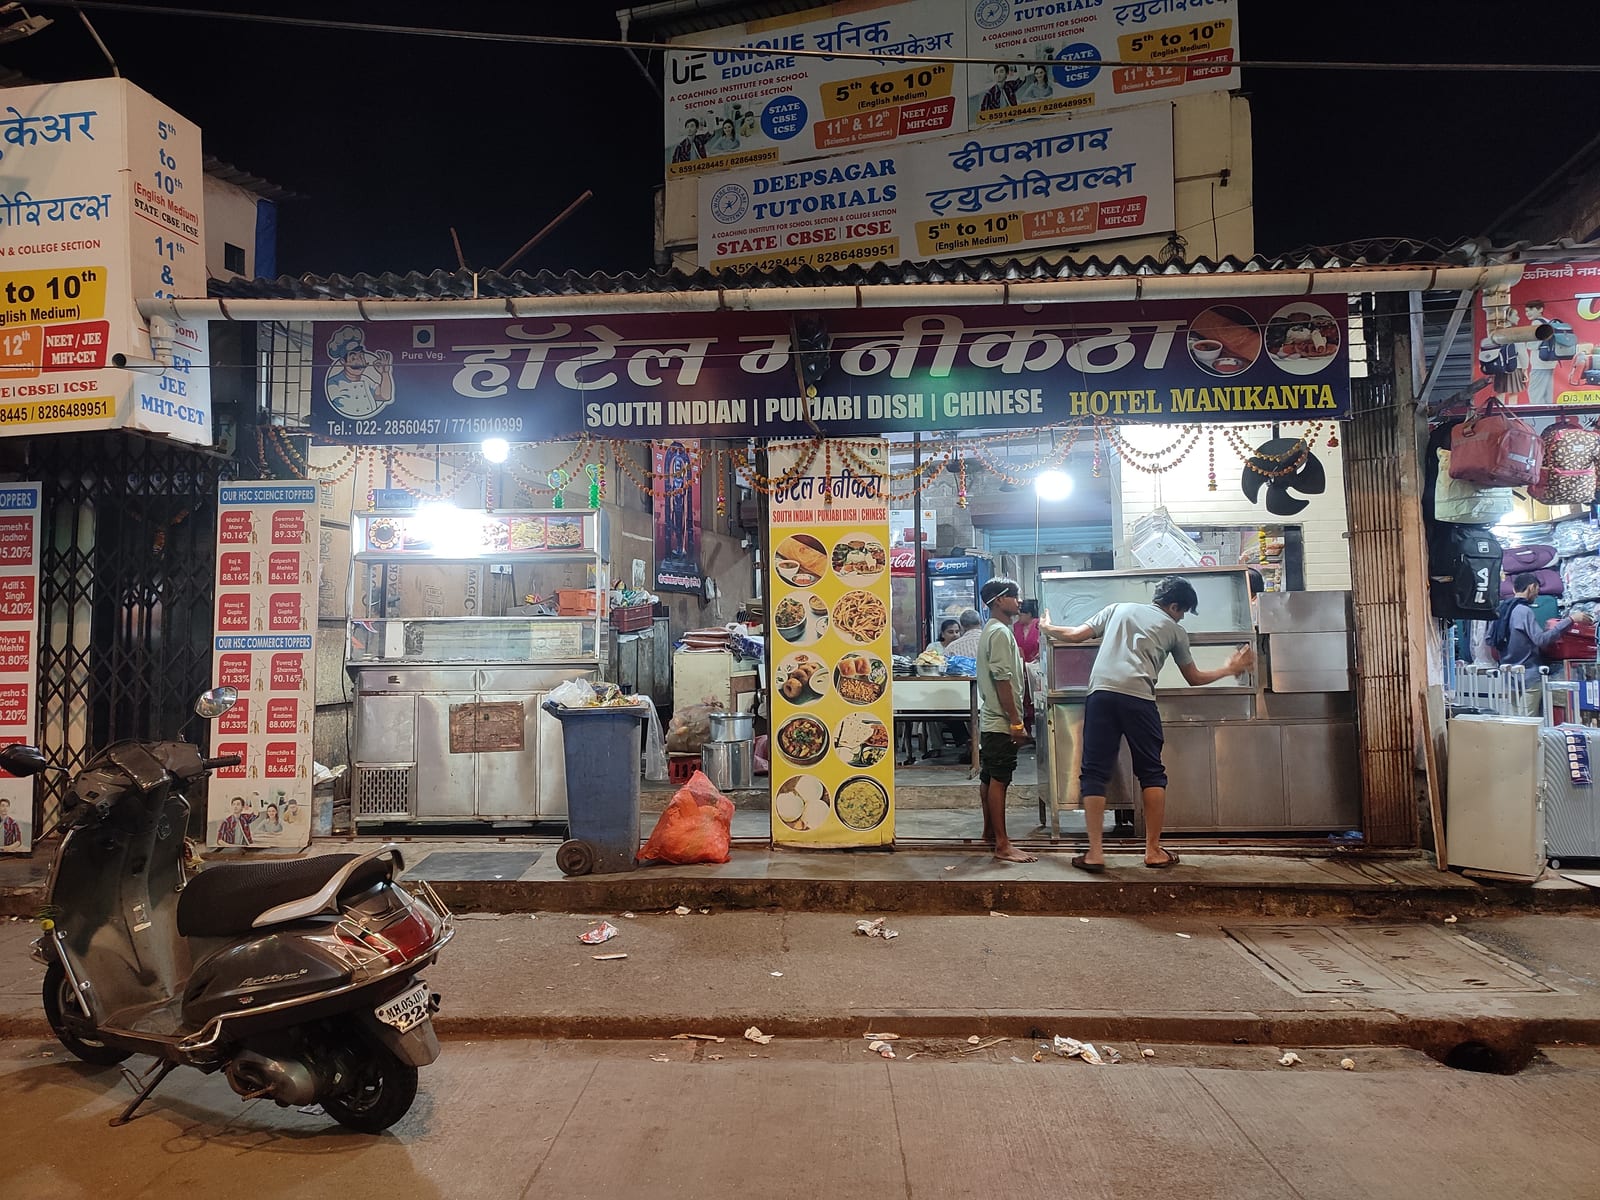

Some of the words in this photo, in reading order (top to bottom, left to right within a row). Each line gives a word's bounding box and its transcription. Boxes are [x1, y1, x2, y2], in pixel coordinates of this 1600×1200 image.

[989, 28, 1023, 42] COACHING
[1024, 23, 1054, 34] INSTITUTE
[1071, 14, 1098, 26] SCHOOL
[994, 39, 1021, 50] SECTION
[1029, 33, 1056, 43] COLLEGE
[1058, 26, 1085, 38] SECTION
[1131, 34, 1154, 52] 5th
[1160, 33, 1182, 46] to
[1189, 21, 1225, 41] 10th
[713, 34, 804, 66] UNIQUE
[1061, 49, 1094, 61] STATE
[1150, 47, 1179, 59] (English
[1180, 42, 1211, 53] Medium)
[721, 56, 796, 80] EDUCARE
[1065, 71, 1091, 83] ICSE
[677, 87, 718, 102] COACHING
[720, 80, 757, 95] INSTITUTE
[776, 71, 809, 84] SCHOOL
[836, 81, 862, 102] 5th
[870, 80, 894, 96] to
[903, 66, 945, 90] 10th
[684, 97, 716, 110] SECTION
[725, 91, 761, 104] COLLEGE
[762, 85, 793, 98] SECTION
[768, 102, 801, 115] STATE
[857, 97, 891, 110] (English
[892, 90, 928, 103] Medium)
[771, 112, 798, 124] CBSE
[826, 117, 849, 136] 11th
[867, 109, 891, 129] 12th
[902, 108, 926, 120] NEET
[931, 104, 949, 117] JEE
[906, 116, 945, 130] MHT-CET
[158, 120, 177, 141] 5th
[773, 124, 797, 135] ICSE
[159, 148, 176, 170] to
[949, 128, 1113, 173] दीपसागर
[678, 158, 724, 174] 8591428445
[730, 151, 777, 166] 8286489951
[154, 171, 183, 195] 10th
[753, 158, 896, 195] DEEPSAGAR
[926, 162, 1137, 217] ट्युटोरियल्स
[133, 181, 166, 208] (English
[167, 194, 199, 227] Medium)
[753, 184, 897, 220] TUTORIALS
[1100, 205, 1121, 215] NEET
[1126, 202, 1142, 213] JEE
[134, 198, 159, 220] STATE
[162, 212, 181, 229] CBSE
[182, 222, 199, 238] ICSE
[717, 227, 748, 239] COACHING
[748, 223, 776, 235] INSTITUTE
[789, 218, 813, 229] SCHOOL
[814, 214, 839, 226] SECTION
[845, 211, 872, 222] COLLEGE
[872, 208, 897, 219] SECTION
[928, 221, 950, 240] 5th
[957, 222, 976, 236] to
[984, 213, 1019, 232] 10th
[1033, 211, 1054, 228] 11th
[1070, 206, 1090, 223] 12th
[1104, 214, 1138, 226] MHT-CET
[18, 242, 58, 255] COLLEGE
[61, 239, 101, 253] SECTION
[155, 236, 185, 261] 11th
[716, 235, 778, 256] STATE
[786, 227, 837, 247] CBSE
[845, 220, 893, 239] ICSE
[935, 238, 971, 253] (English
[972, 234, 1009, 247] Medium)
[817, 245, 894, 264] 8286489951
[5, 281, 35, 304] to
[46, 270, 97, 300] 10th
[31, 307, 81, 322] Medium)
[3, 330, 31, 357] 12th
[46, 334, 74, 348] NEET
[82, 332, 102, 346] JEE
[51, 351, 97, 365] MHT-CET
[402, 351, 423, 360] Pure
[425, 350, 446, 360] Veg.
[452, 323, 719, 399] हॉटेल
[18, 384, 57, 397] CBSE
[63, 381, 98, 394] ICSE
[159, 375, 187, 397] JEE
[38, 401, 108, 420] 8286489951
[141, 394, 205, 426] MHT-CET
[587, 402, 662, 427] SOUTH
[668, 400, 746, 425] INDIAN
[765, 395, 861, 422] PUNJABI
[867, 393, 924, 419] DISH
[943, 389, 1043, 417] CHINESE
[1069, 389, 1162, 416] HOTEL
[1170, 384, 1337, 414] MANIKANTA
[327, 421, 351, 436] Tel.:
[355, 420, 382, 435] 022-
[385, 419, 441, 435] 28560457
[452, 417, 523, 434] 7715010399
[222, 491, 237, 501] OUR
[239, 490, 253, 501] HSC
[254, 490, 284, 500] SCIENCE
[285, 490, 314, 500] TOPPERS
[772, 510, 792, 523] SOUTH
[793, 509, 814, 523] INDIAN
[817, 509, 842, 522] PUNJABI
[843, 508, 857, 521] DISH
[861, 508, 886, 521] CHINESE
[1, 533, 28, 542] Jadhav
[946, 561, 968, 570] pepsi
[1474, 567, 1489, 603] FILA
[5, 592, 25, 601] Singh
[218, 638, 231, 649] OUR
[233, 638, 246, 648] HSC
[247, 638, 284, 648] COMMERCE
[284, 637, 310, 648] TOPPERS
